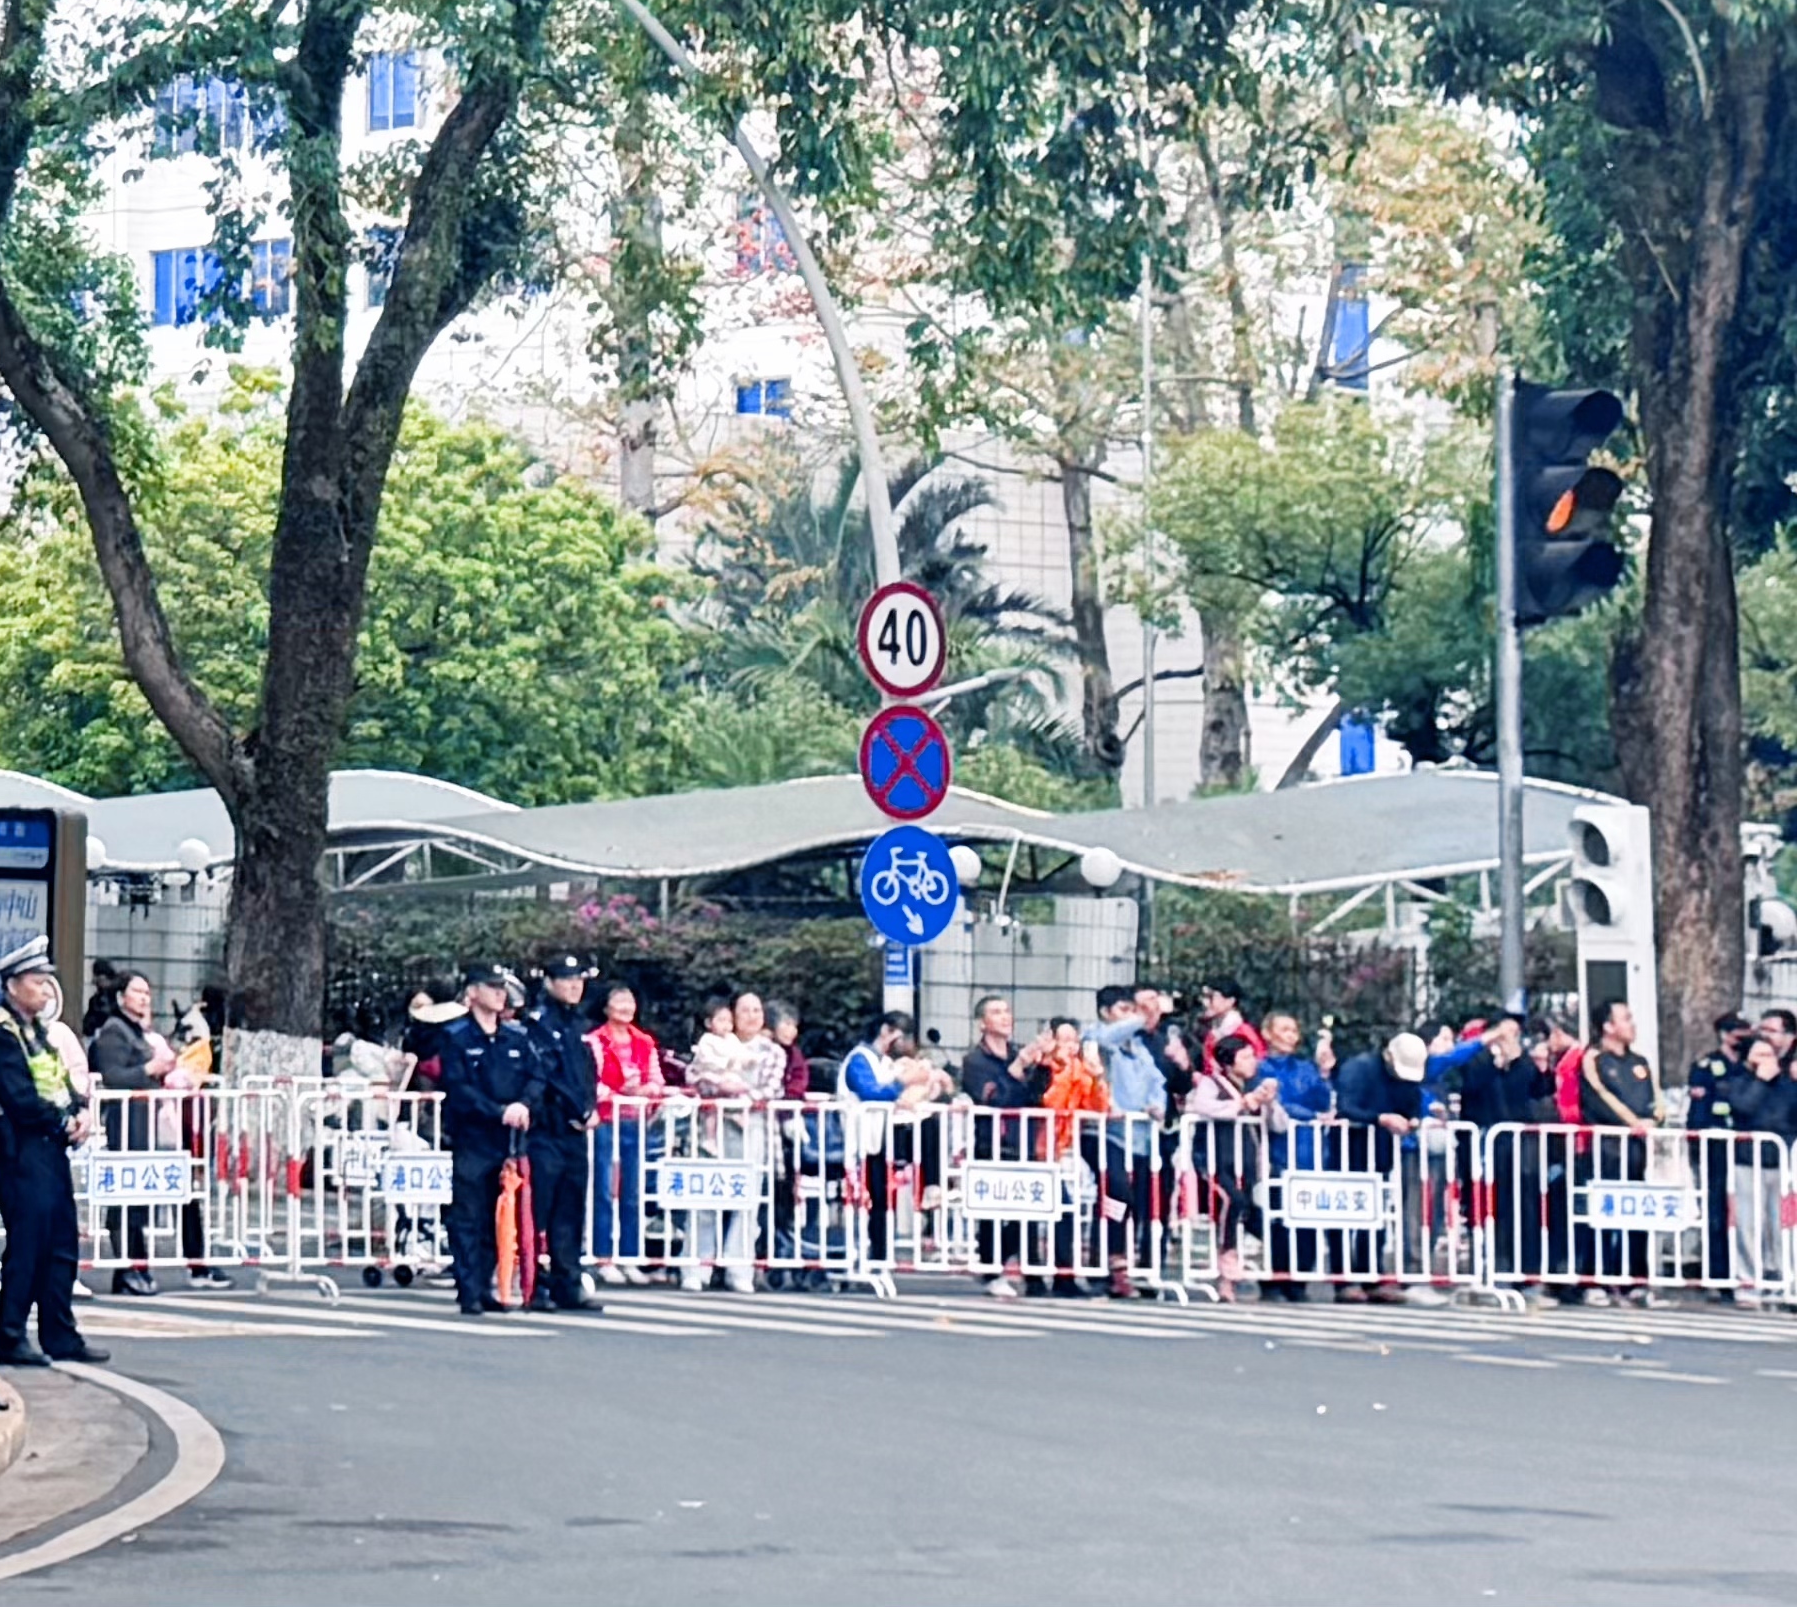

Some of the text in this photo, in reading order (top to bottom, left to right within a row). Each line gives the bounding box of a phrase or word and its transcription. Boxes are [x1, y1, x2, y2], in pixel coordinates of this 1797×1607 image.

[878, 608, 927, 666] 40
[97, 1164, 182, 1192] 港口公安
[667, 1171, 746, 1198] 港口公安
[973, 1177, 1045, 1203] 中山公安
[1296, 1188, 1367, 1212] 中山公安
[1601, 1193, 1679, 1218] 港口公安
